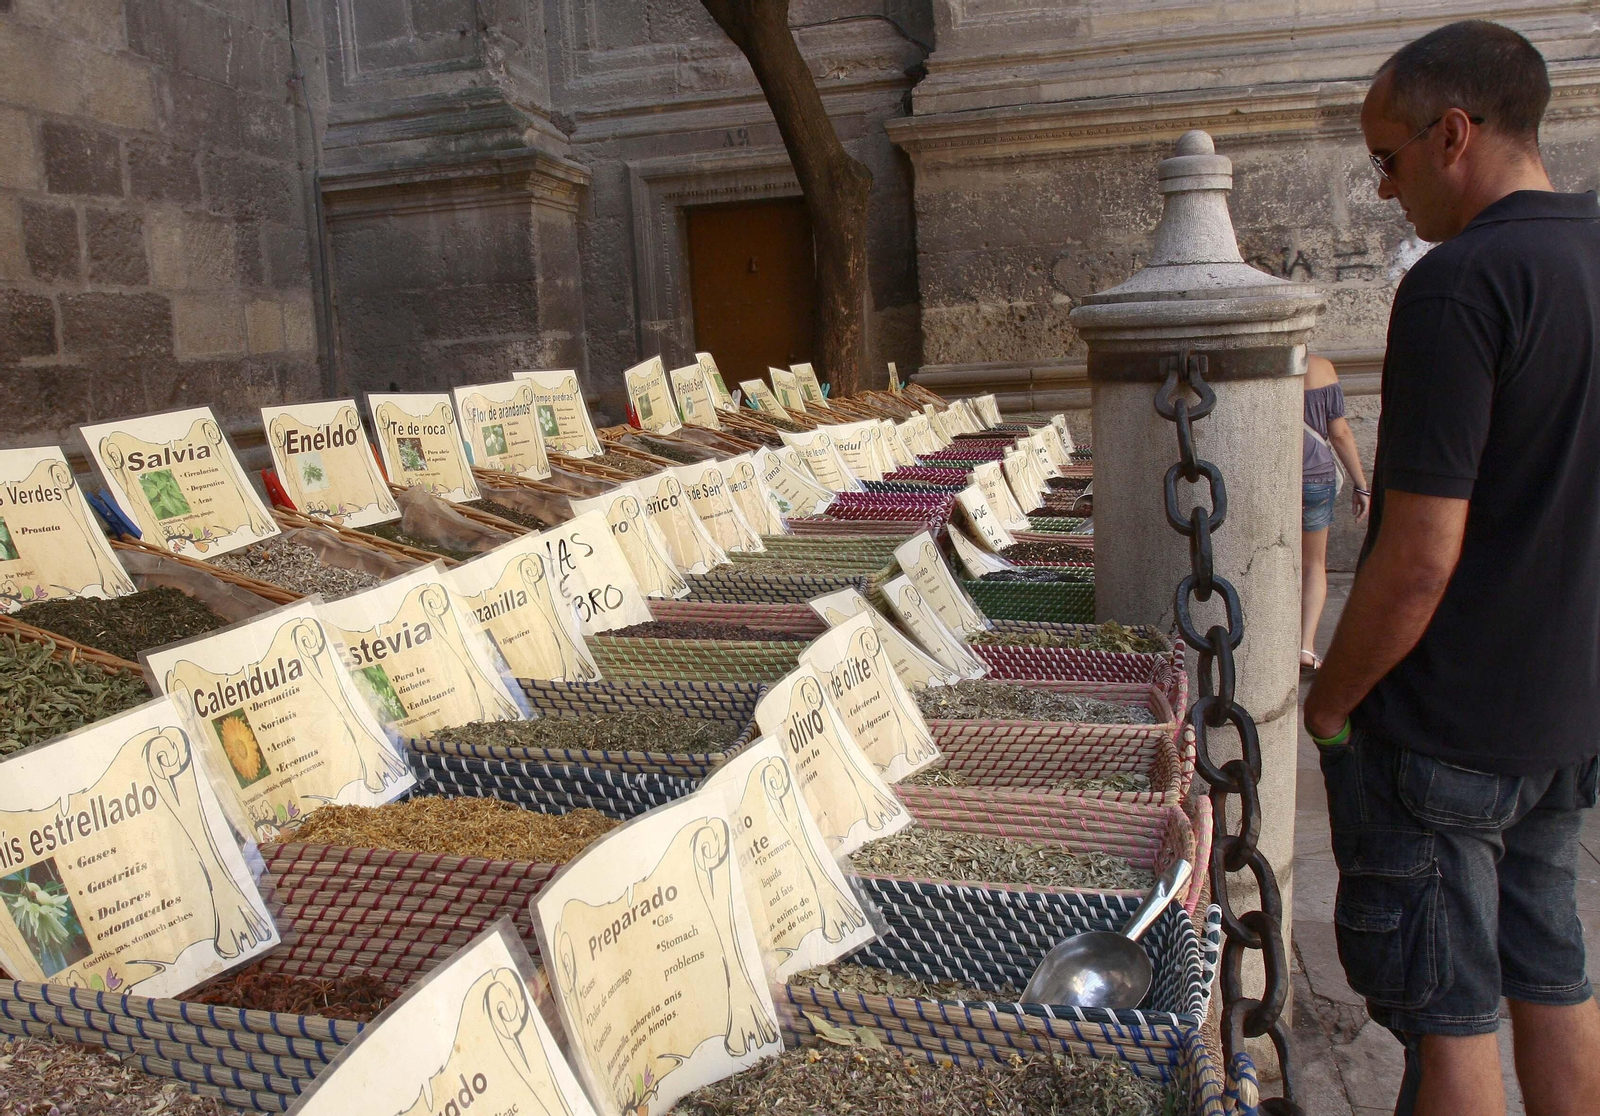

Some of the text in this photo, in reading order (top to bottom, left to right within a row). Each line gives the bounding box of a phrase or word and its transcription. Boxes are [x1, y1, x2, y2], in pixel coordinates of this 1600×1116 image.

[472, 408, 487, 423] Flor
[488, 406, 497, 421] de
[286, 423, 358, 455] Enéldo
[407, 422, 420, 436] de
[423, 424, 446, 436] roca
[128, 443, 212, 472] Salvia
[7, 485, 62, 505] Verdes
[692, 486, 701, 500] de
[702, 484, 720, 498] Sen
[21, 525, 61, 536] Prostata
[398, 678, 431, 694] diabetes
[843, 656, 871, 691] olite
[194, 657, 304, 718] Caléndula
[252, 686, 300, 712] Dermatitis
[261, 710, 297, 732] Soriasis
[788, 708, 824, 754] olivo
[270, 735, 296, 753] Acnés
[812, 748, 820, 758] la
[278, 748, 320, 774] Eccemas
[30, 781, 157, 856] estrellado
[77, 846, 117, 869] Gases
[757, 839, 792, 866] To remove
[87, 862, 148, 894] Gastritis
[760, 868, 782, 888] liquids
[97, 890, 152, 921] Dolores
[769, 884, 794, 907] and fats
[97, 896, 182, 942] estomacales
[588, 885, 678, 962] Preparado
[656, 912, 674, 928] Gas
[776, 904, 798, 924] estima
[800, 897, 810, 906] de
[788, 920, 796, 932] de
[83, 912, 194, 970] Gastritis, gas, stomach aches
[660, 925, 700, 954] Stomach
[664, 950, 705, 982] problems
[664, 990, 682, 1006] anís
[648, 1010, 678, 1036] hinojos.
